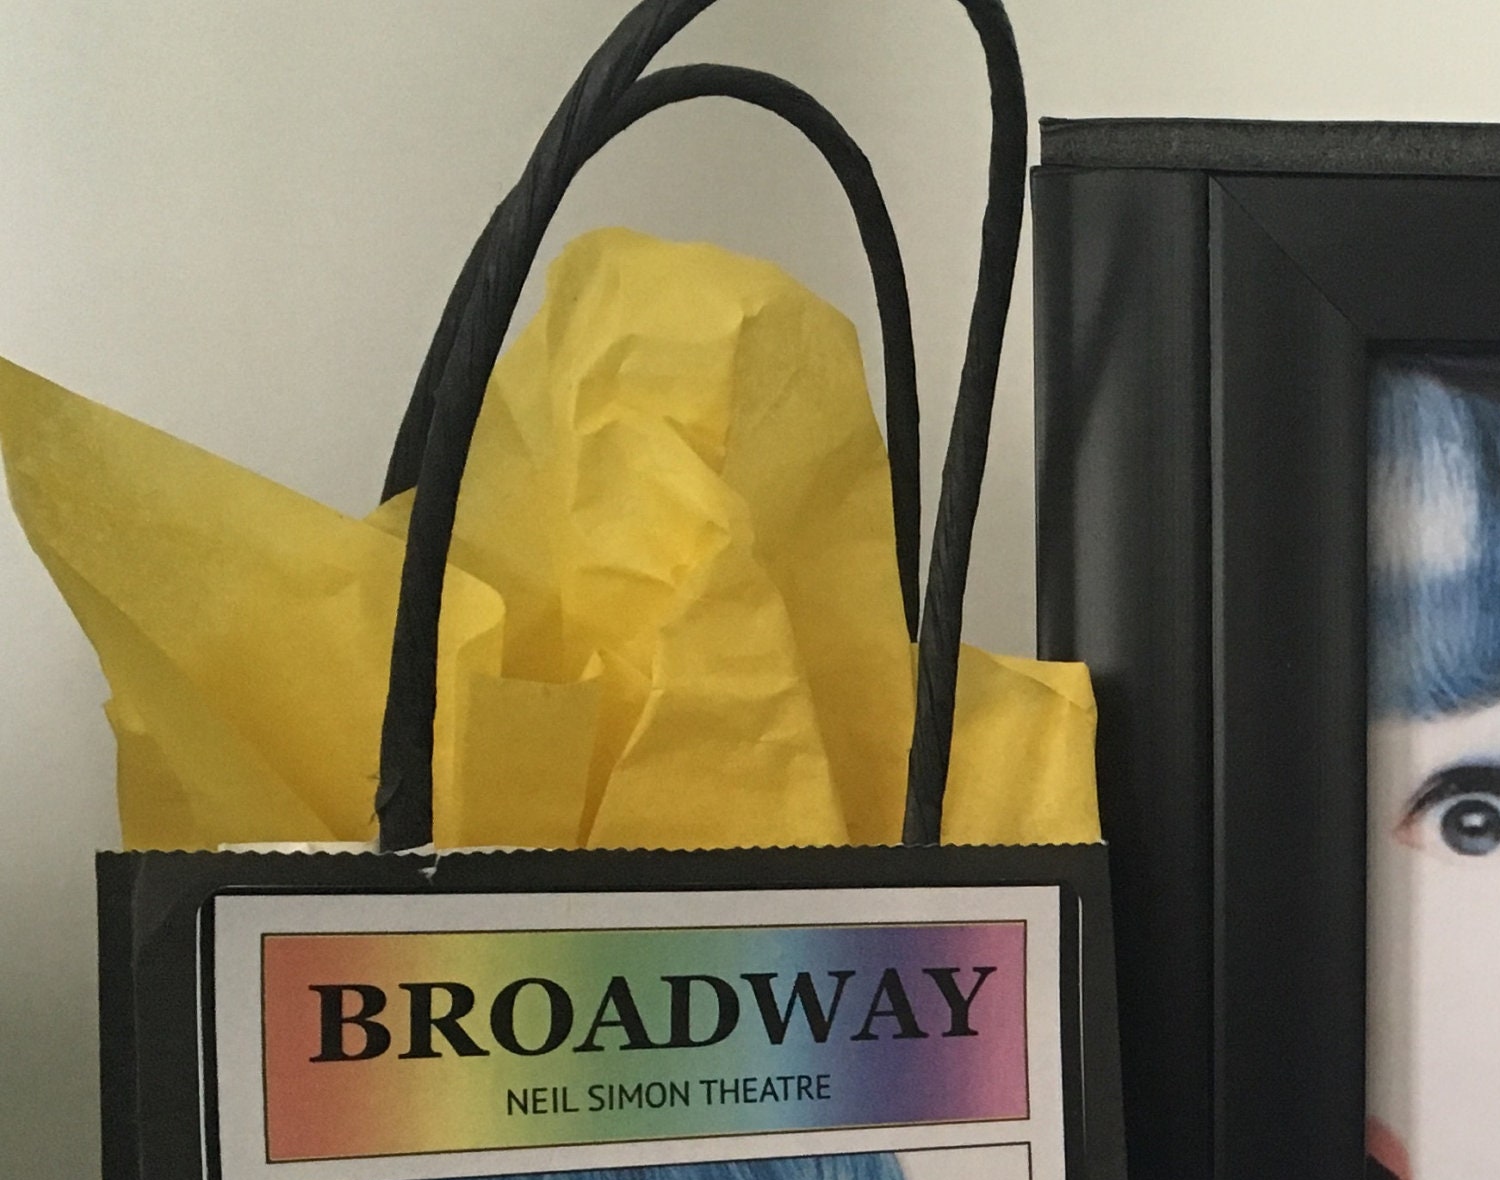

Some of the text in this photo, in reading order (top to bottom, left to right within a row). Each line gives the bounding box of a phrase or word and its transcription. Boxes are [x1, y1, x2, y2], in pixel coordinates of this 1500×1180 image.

[308, 966, 997, 1063] BROADWAY
[506, 1074, 832, 1116] NEIL SIMON THEATRE
